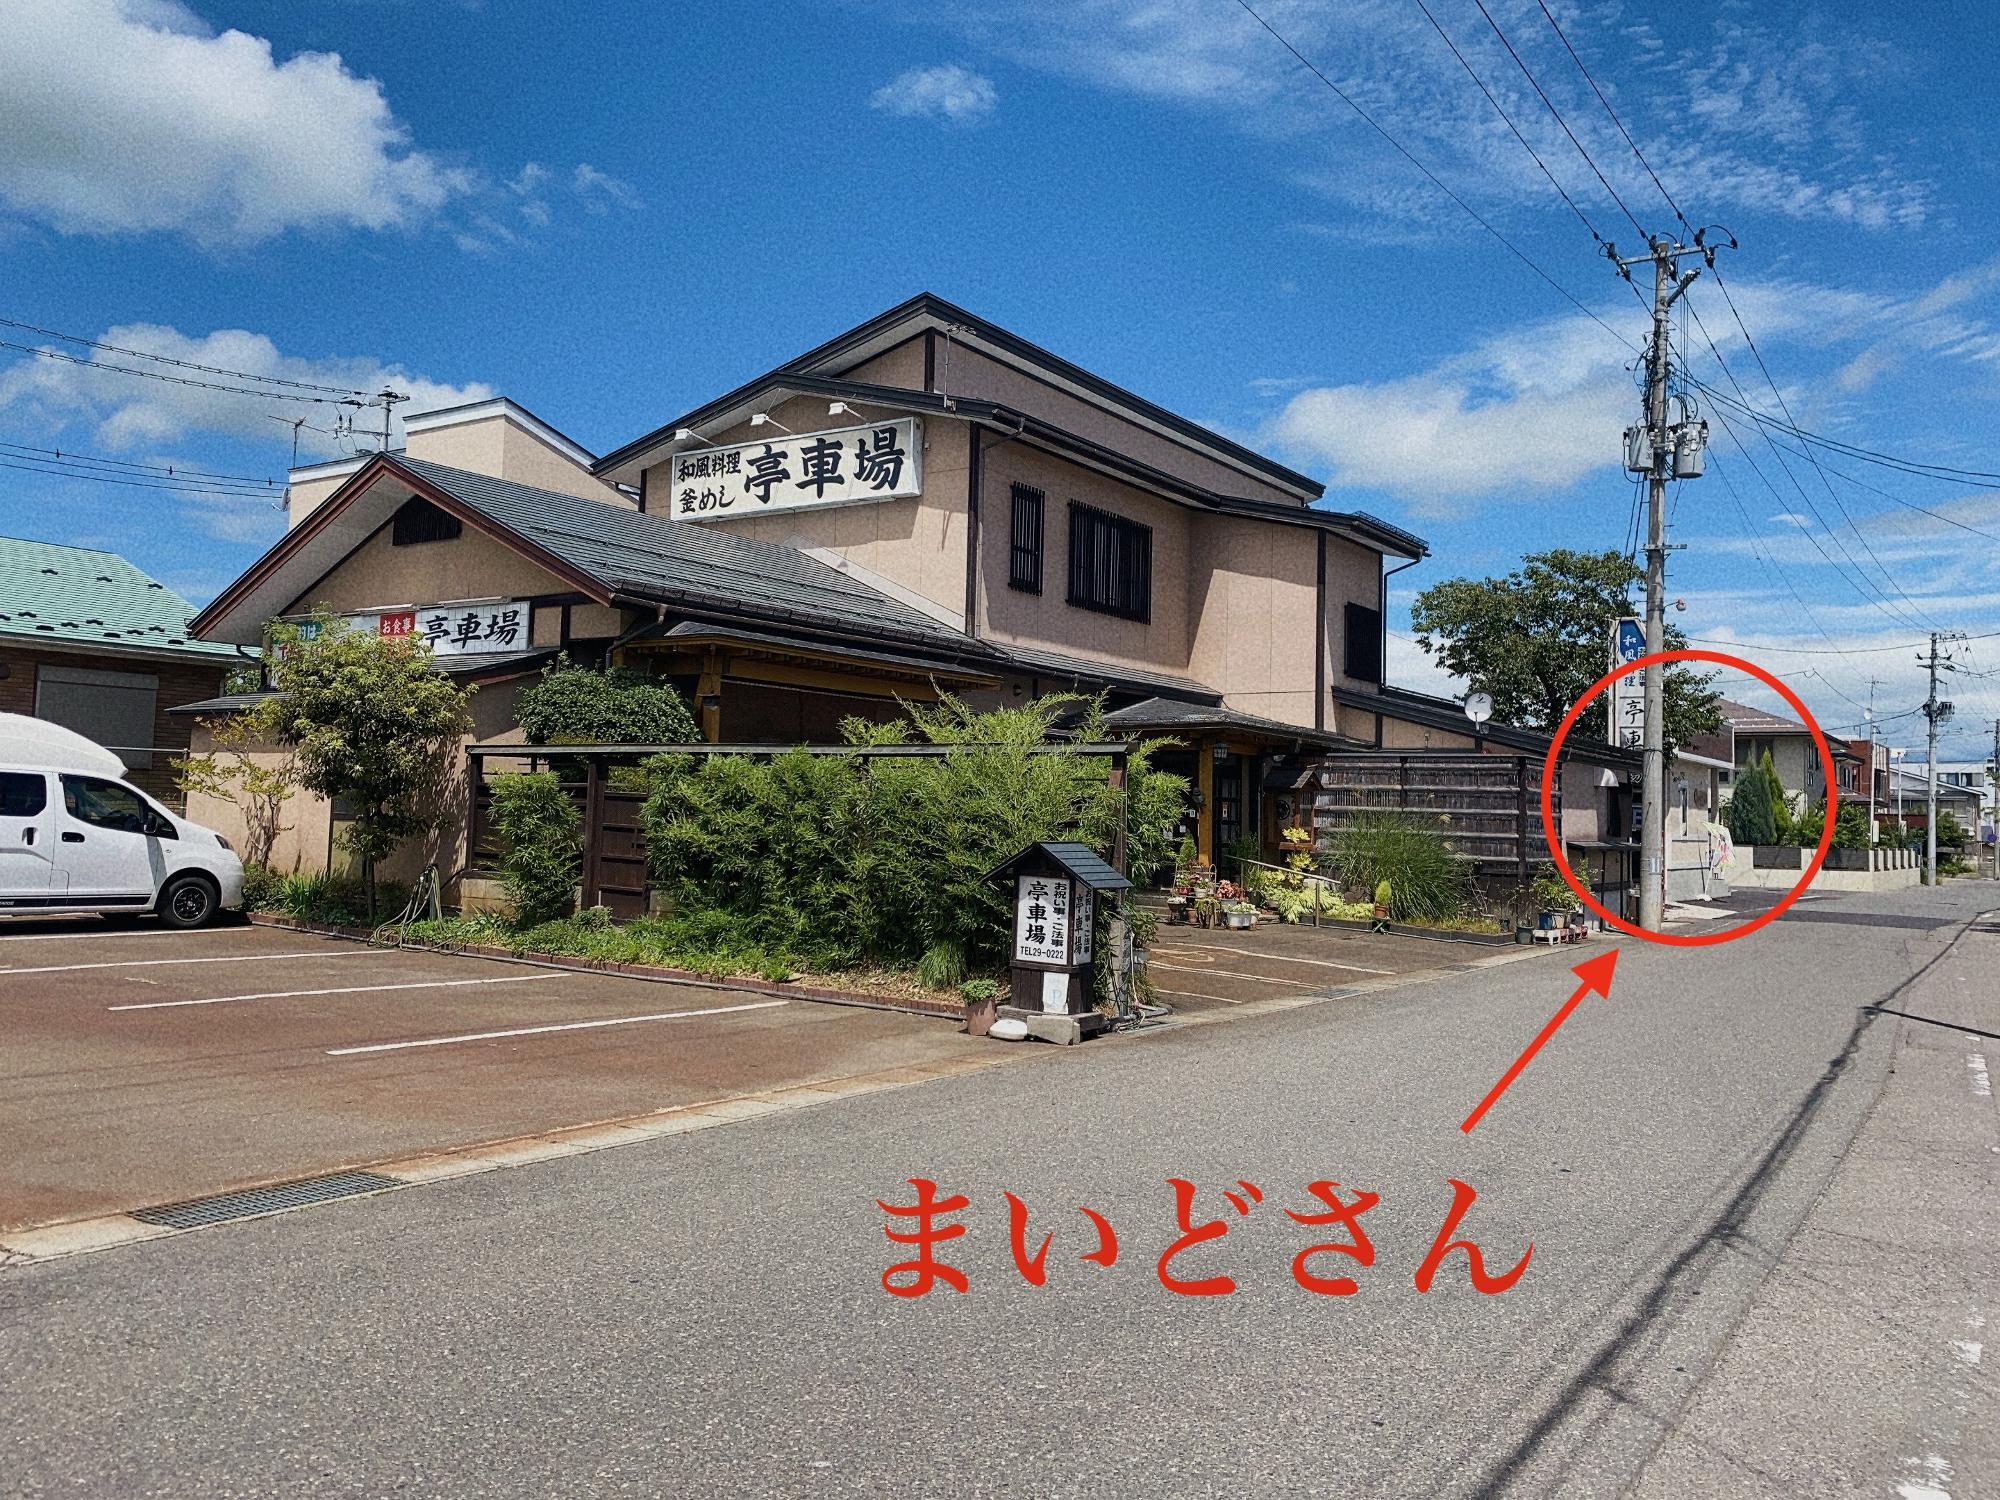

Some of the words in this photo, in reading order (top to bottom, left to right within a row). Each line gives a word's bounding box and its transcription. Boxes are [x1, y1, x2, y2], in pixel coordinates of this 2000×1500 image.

[677, 450, 741, 481] 和風料理
[744, 427, 905, 504] 亭車場
[679, 485, 736, 513] 釜めし
[382, 617, 411, 635] お食事
[423, 609, 520, 649] 亭車場
[1622, 634, 1637, 687] 和風理
[1025, 881, 1049, 945] 亭車場
